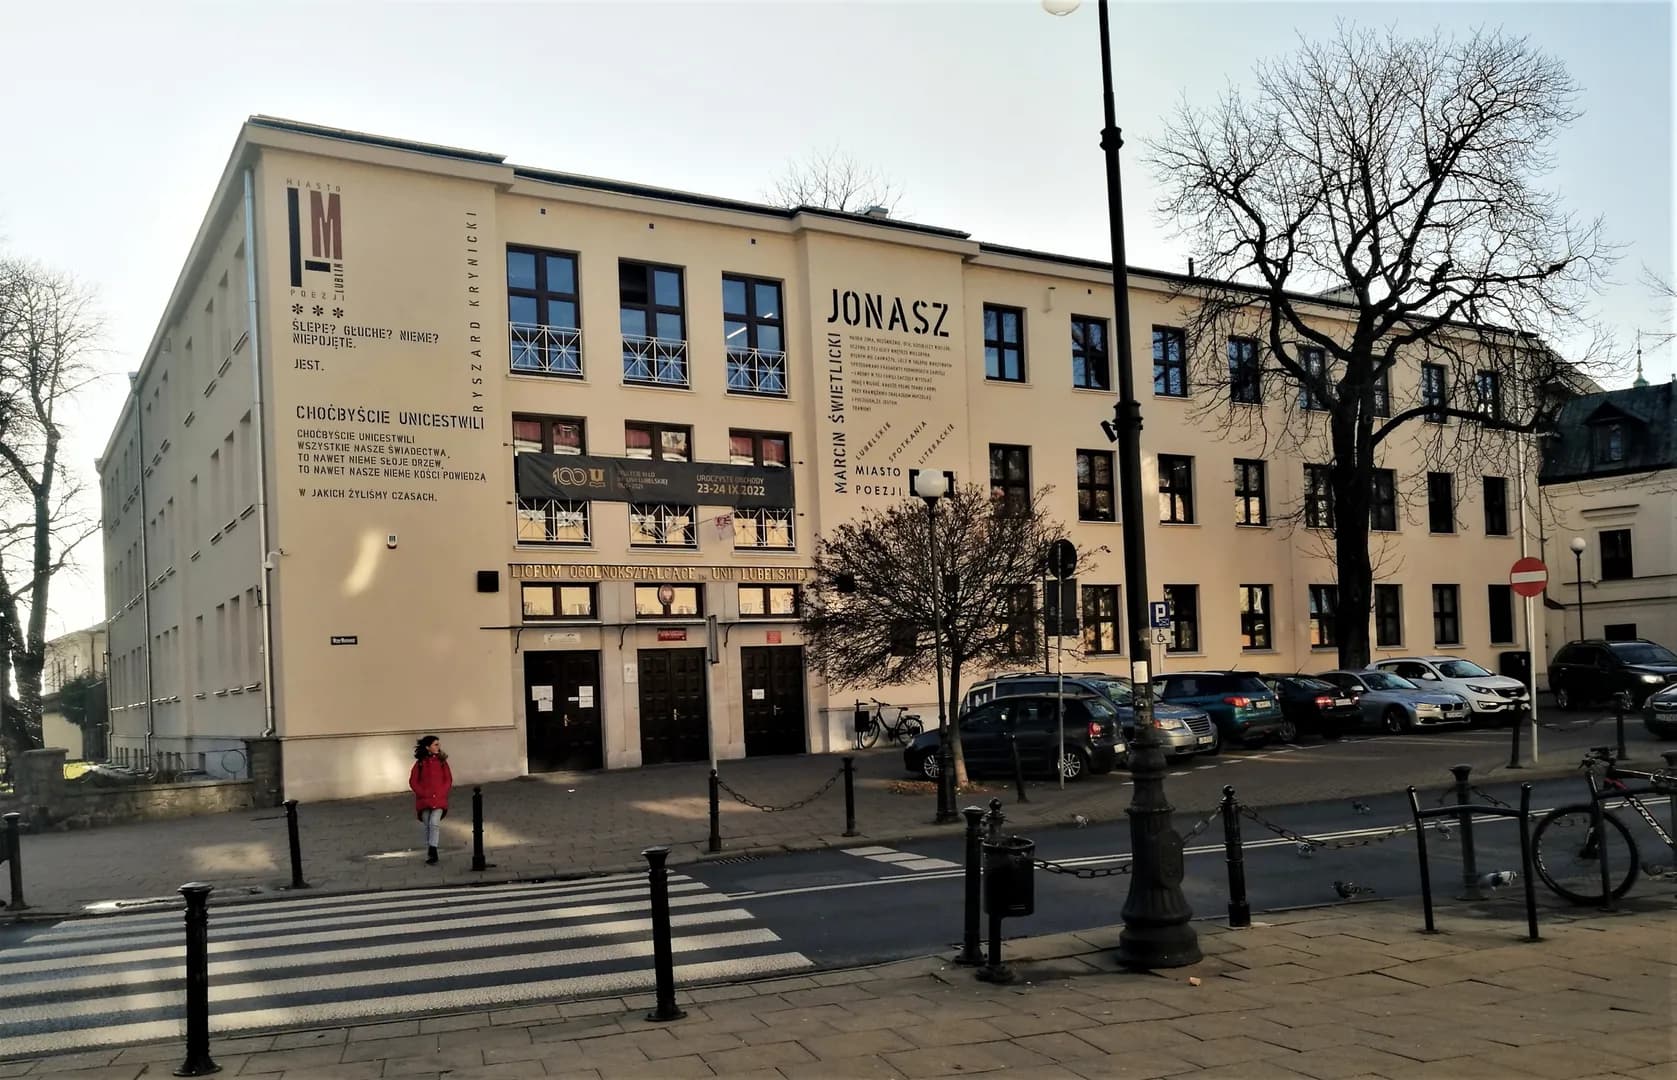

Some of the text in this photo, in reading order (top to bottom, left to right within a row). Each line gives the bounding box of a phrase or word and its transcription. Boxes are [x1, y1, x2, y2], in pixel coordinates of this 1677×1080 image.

[286, 178, 341, 193] MIASTO
[465, 211, 484, 413] RYSZARD KRYNICKI
[827, 288, 949, 338] JONASZ
[292, 317, 336, 334] ŚLEPE?
[399, 329, 439, 344] NIEME?
[294, 358, 325, 371] JEST.
[296, 403, 484, 430] CHOĆBYŚCIE UNICESTWILI
[828, 333, 848, 494] MARCIN ŚWIETLICKI
[358, 431, 416, 444] UNICESTWILI
[855, 421, 892, 461] LUBELSKIE
[888, 420, 928, 464] SPOTKANIA
[297, 440, 351, 452] WSZYSTKIE
[354, 443, 385, 454] NASZE
[298, 452, 310, 463] TO
[313, 453, 345, 464] NAWET
[349, 455, 377, 465] NIEME
[380, 456, 408, 467] SŁOJE
[298, 464, 310, 474] TO
[313, 465, 345, 475] NAWET
[349, 467, 381, 477] NASZE
[384, 468, 411, 479] NIEME
[414, 467, 440, 480] KOŚCI
[855, 465, 902, 478] MIASTO
[298, 488, 306, 497] W
[311, 488, 345, 498] JAKICH
[348, 487, 388, 500] ŻYLIŚMY
[697, 483, 766, 496] 23-24 IX 2022
[855, 485, 902, 497] POEZJI
[511, 564, 561, 579] LICEUM
[1155, 604, 1166, 623] P
